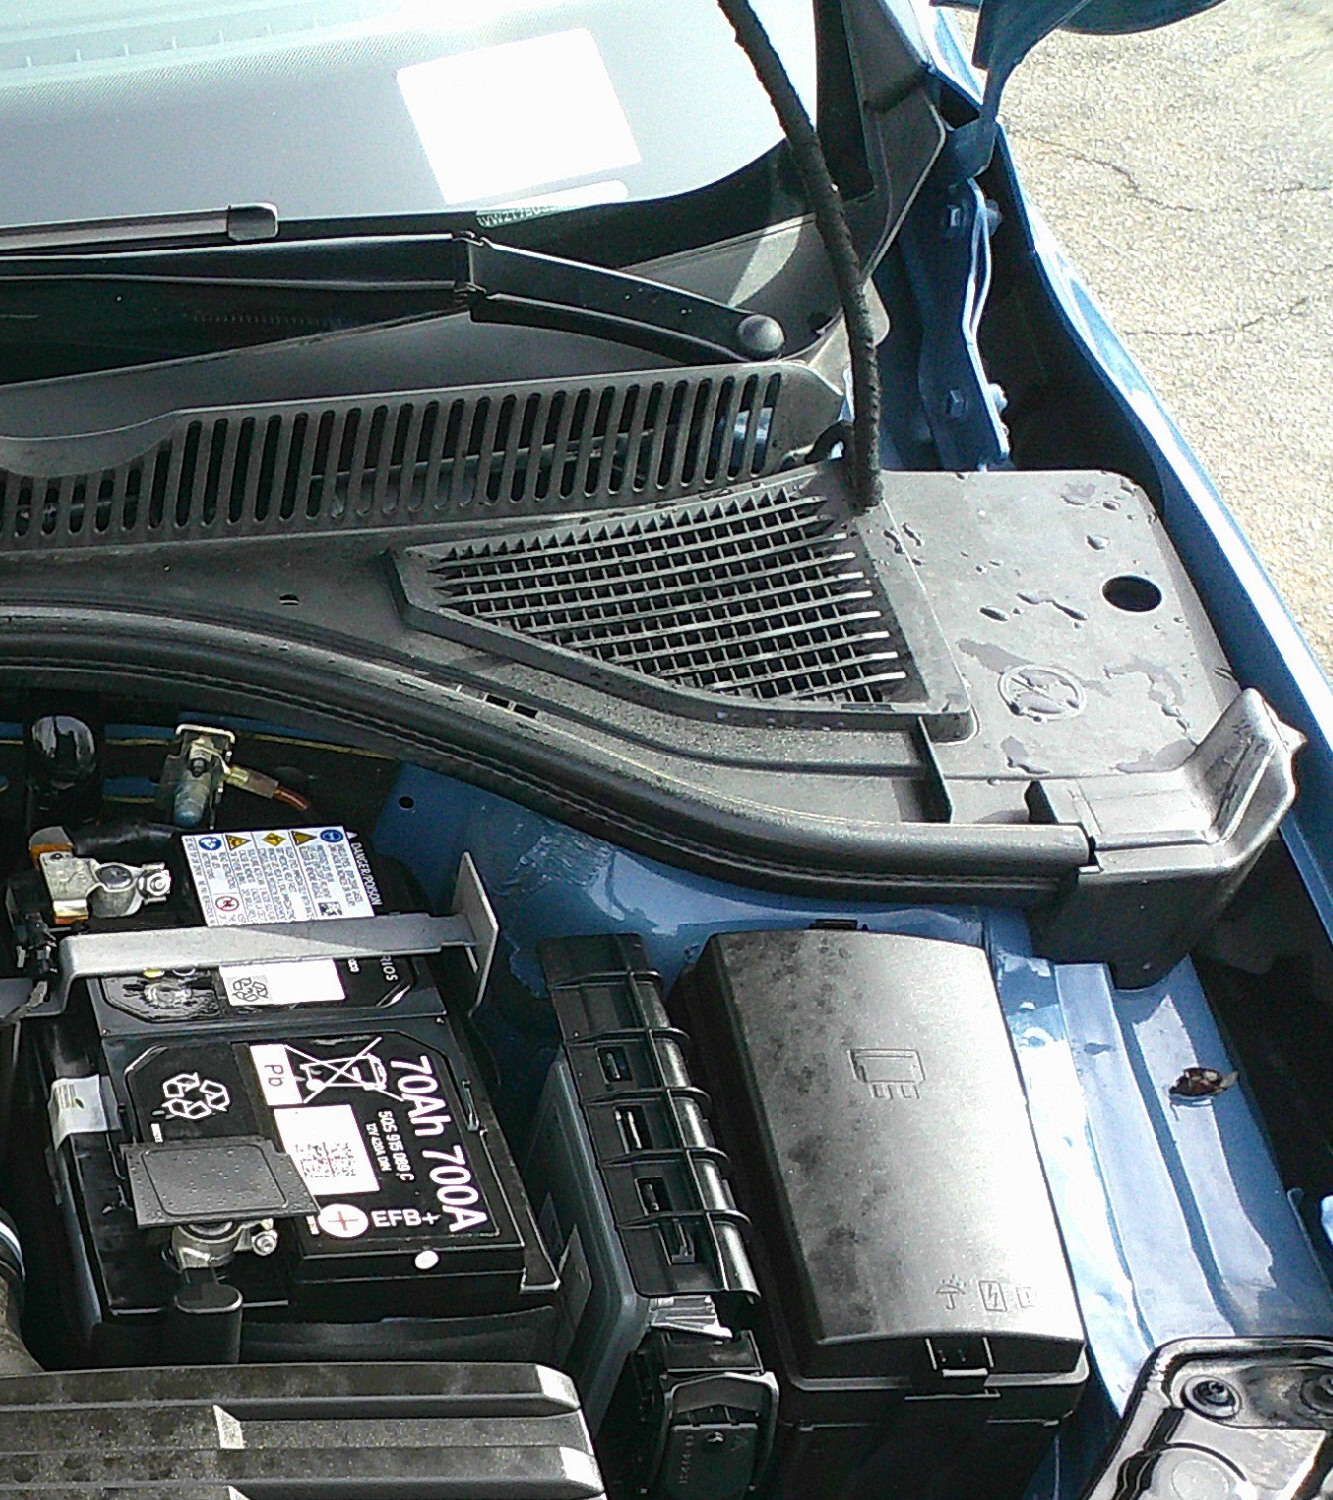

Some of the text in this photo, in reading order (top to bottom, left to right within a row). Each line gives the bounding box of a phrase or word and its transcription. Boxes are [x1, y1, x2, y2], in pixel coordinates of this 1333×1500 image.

[350, 842, 383, 906] DANGER/POISON
[264, 1064, 284, 1087] Pb
[390, 1055, 488, 1233] 70Ah 700A
[371, 1208, 442, 1230] EFB+
